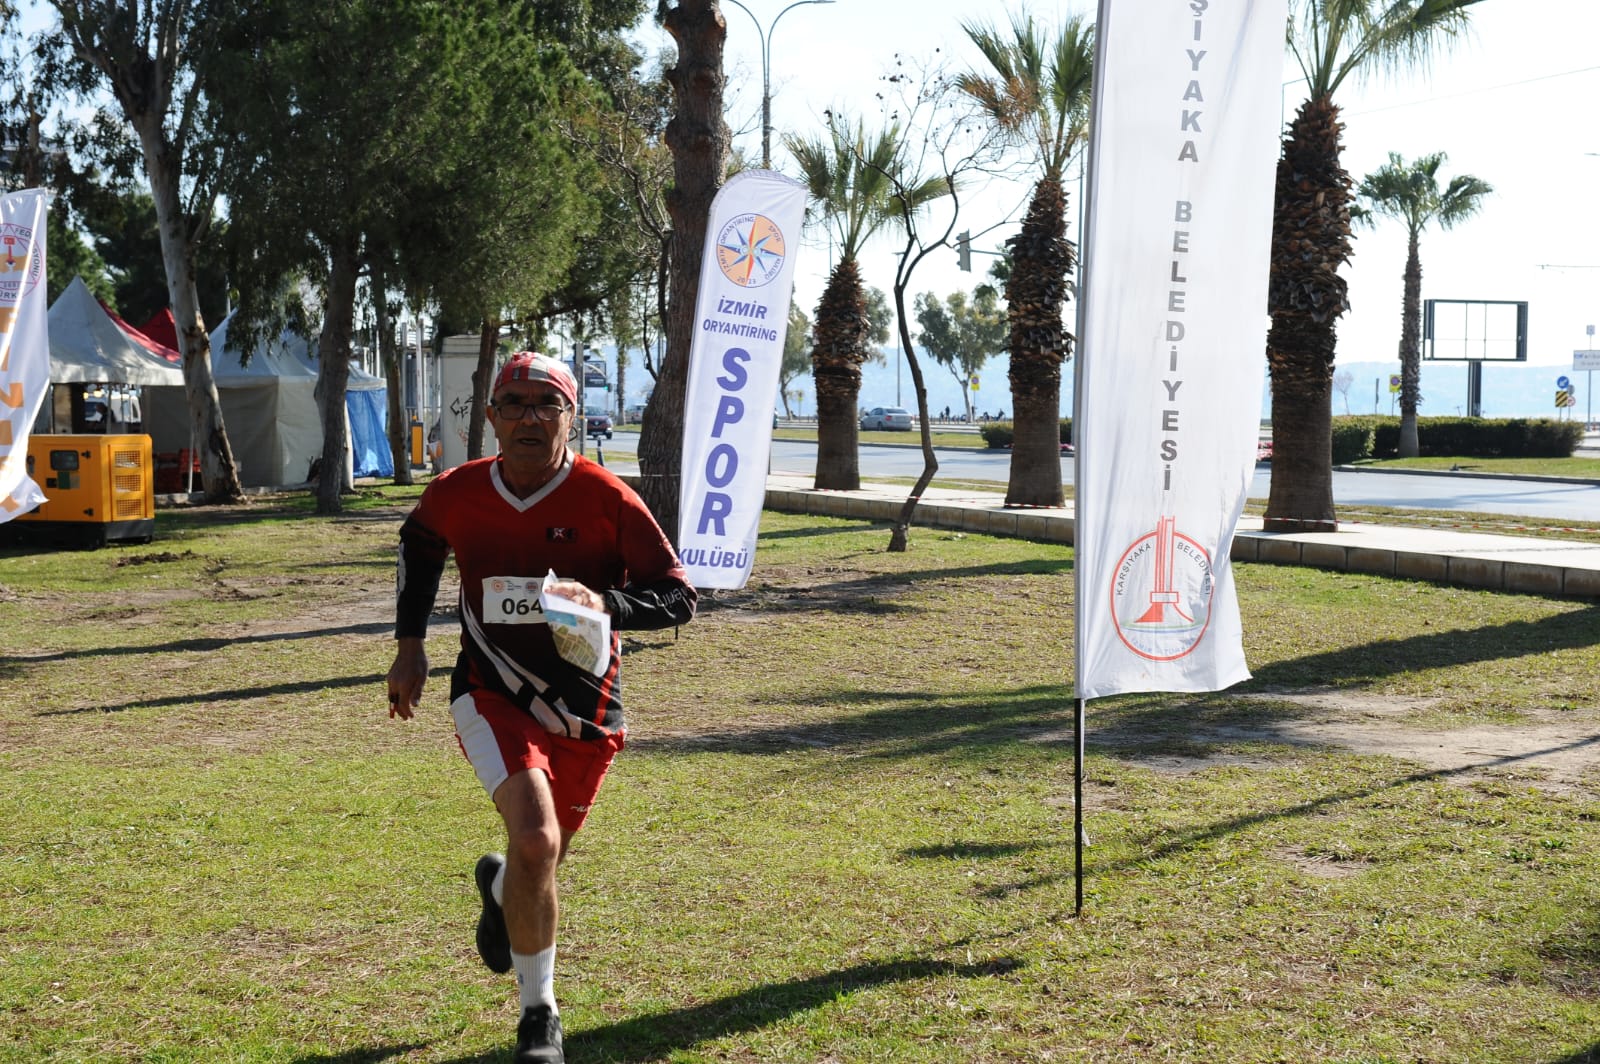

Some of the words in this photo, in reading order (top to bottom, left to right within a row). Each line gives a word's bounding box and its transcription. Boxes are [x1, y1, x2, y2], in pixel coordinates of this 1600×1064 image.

[717, 295, 768, 320] İZMİR
[702, 318, 778, 342] ORYANTİRİNG
[1160, 200, 1193, 491] BELEDİYESİ
[696, 347, 752, 537] SPOR
[679, 545, 749, 569] KULÜBÜ
